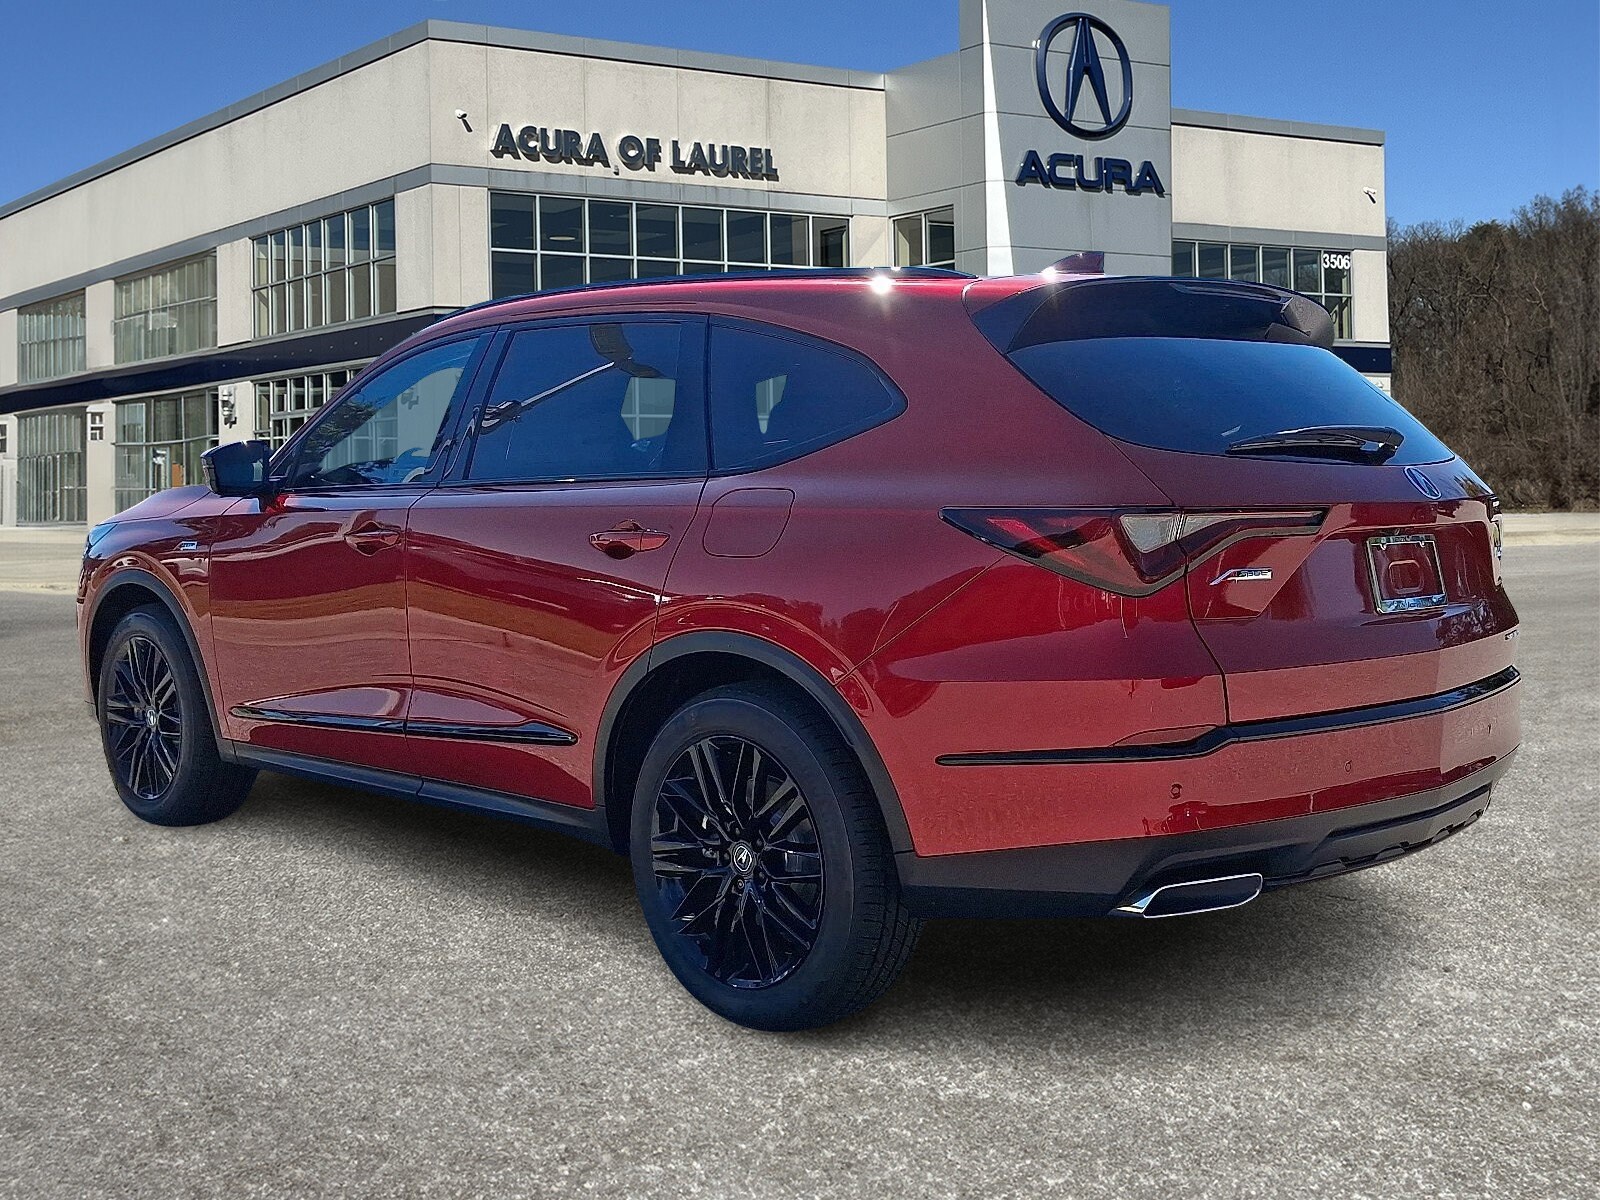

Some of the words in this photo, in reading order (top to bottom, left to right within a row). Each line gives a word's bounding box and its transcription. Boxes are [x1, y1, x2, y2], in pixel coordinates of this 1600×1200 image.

[490, 123, 610, 168] ACURA
[617, 134, 662, 171] OF
[670, 139, 779, 181] LAUREL
[1015, 149, 1165, 198] ACURA
[1322, 253, 1350, 269] 3506
